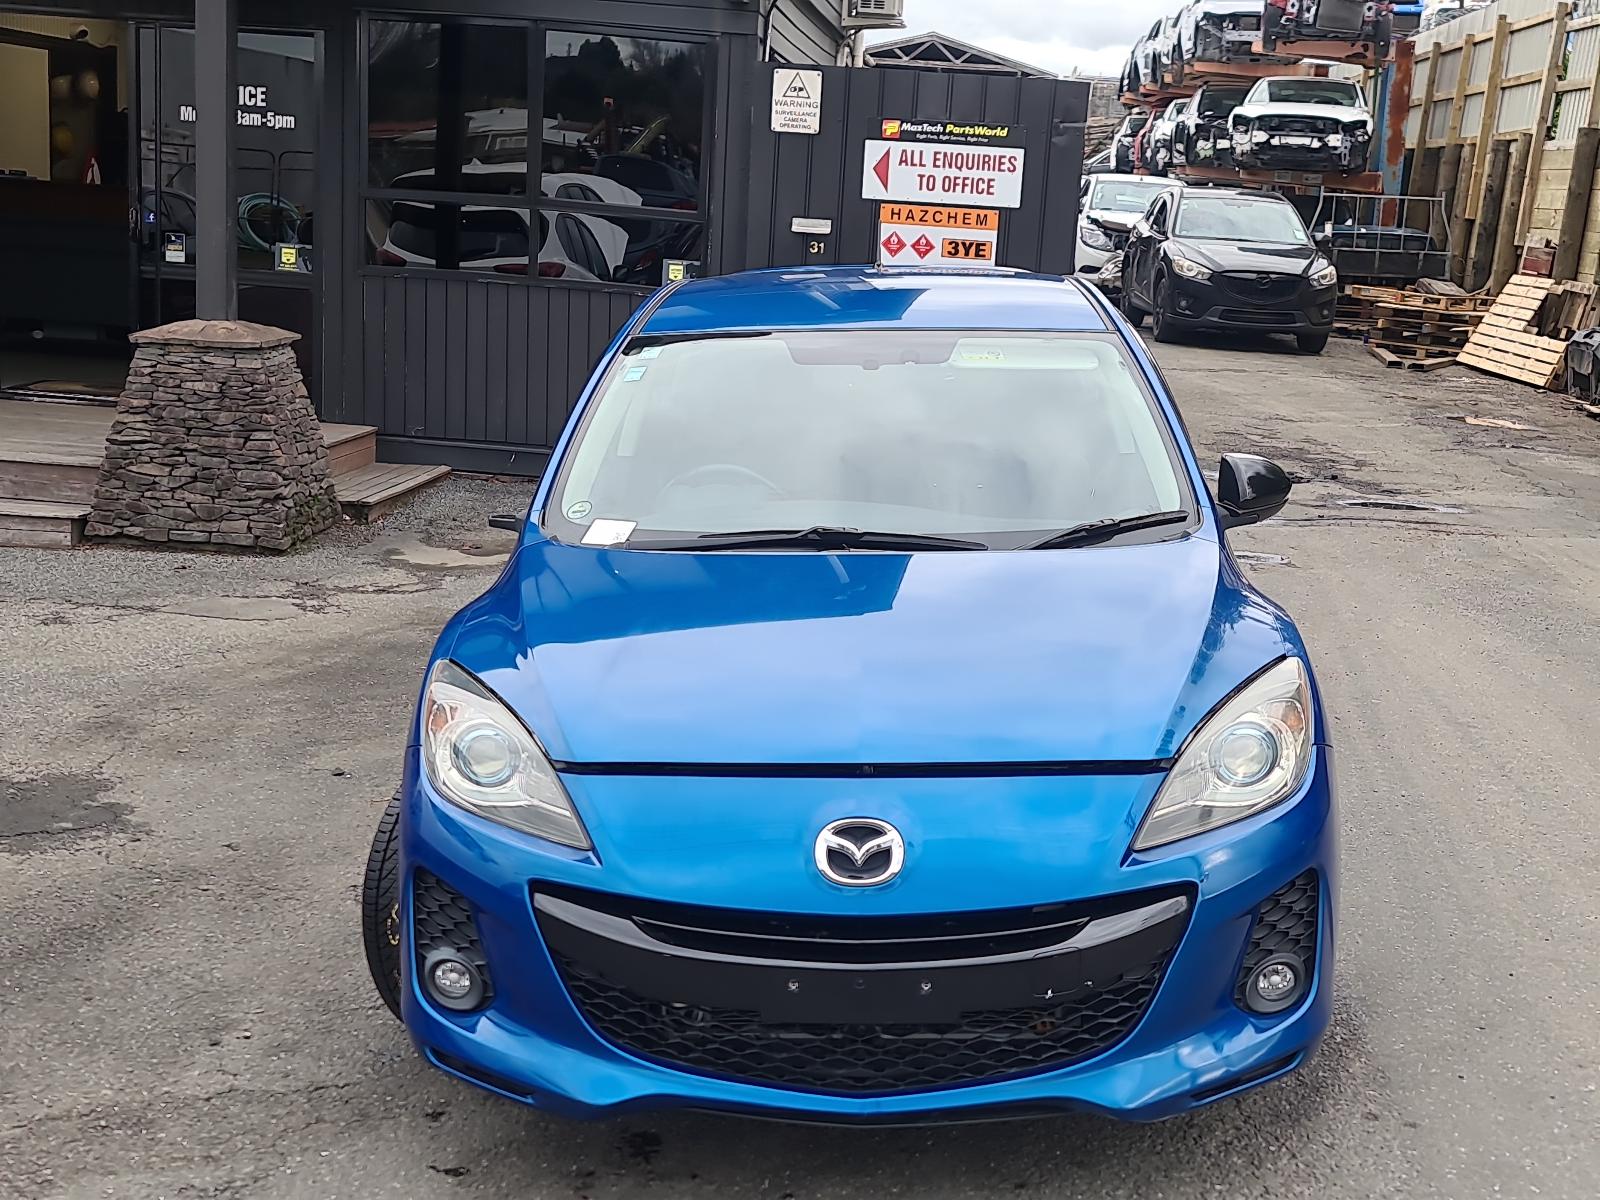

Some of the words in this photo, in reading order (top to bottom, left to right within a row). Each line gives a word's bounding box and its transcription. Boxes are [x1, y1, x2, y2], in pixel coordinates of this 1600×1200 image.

[774, 98, 819, 109] WARNING
[774, 109, 817, 118] SURVEILLANCE
[779, 122, 812, 130] OPERATING
[945, 123, 1009, 137] PartsWorld
[898, 149, 927, 168] ALL
[932, 150, 1018, 173] ENQUIRIES
[917, 174, 936, 192] TO
[942, 175, 996, 195] OFFICE
[890, 207, 988, 226] HAZCHEM
[809, 241, 825, 254] 31
[947, 240, 987, 258] 3YE
